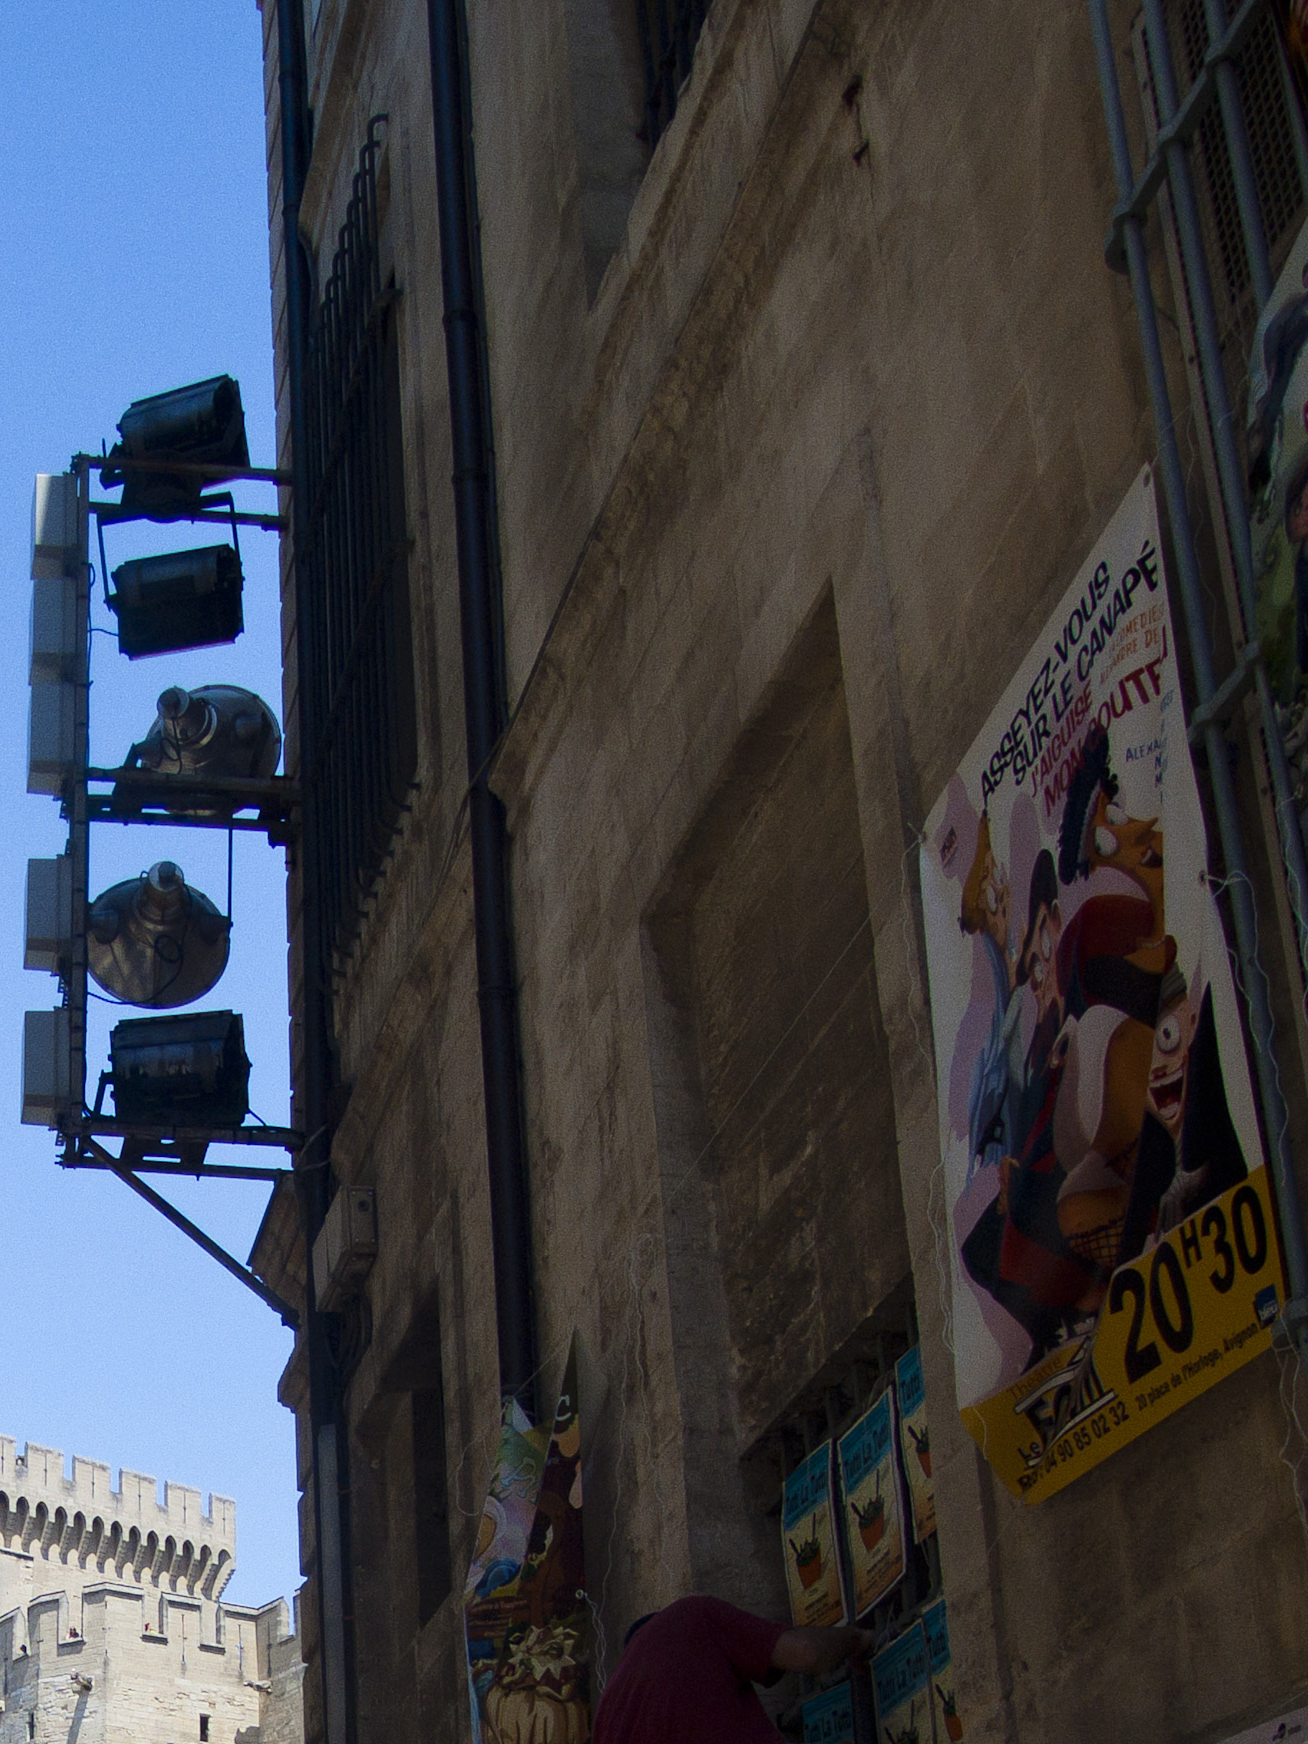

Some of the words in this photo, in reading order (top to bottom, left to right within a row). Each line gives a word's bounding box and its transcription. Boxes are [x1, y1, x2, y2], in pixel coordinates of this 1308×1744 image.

[980, 561, 1110, 807] ASSEYEZ-VOUS
[1013, 714, 1051, 787] SUR
[1053, 671, 1074, 723] LE
[1077, 540, 1158, 682] CANAPÉ
[1032, 678, 1093, 798] J'AIGUISE
[1057, 1439, 1074, 1462] 90
[1073, 1426, 1091, 1450] 85
[1091, 1414, 1111, 1438] 02
[1109, 1401, 1129, 1426] 32
